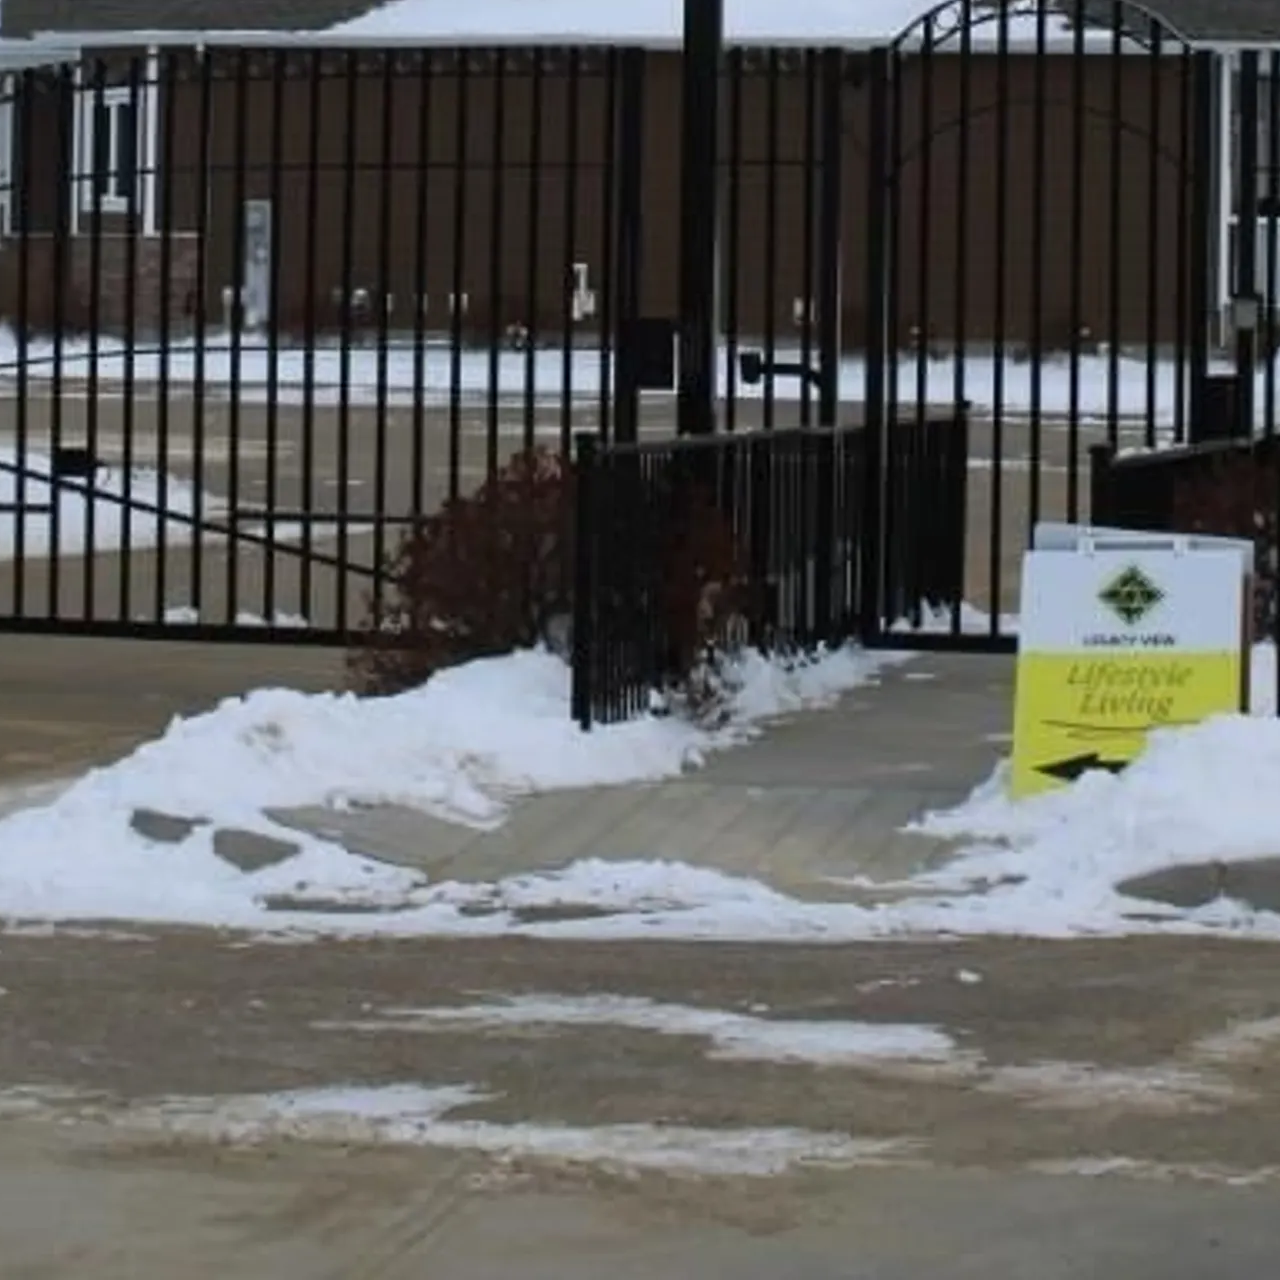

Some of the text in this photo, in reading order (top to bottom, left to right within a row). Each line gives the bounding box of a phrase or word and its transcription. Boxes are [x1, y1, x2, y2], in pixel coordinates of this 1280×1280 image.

[1140, 633, 1175, 648] VIEW
[1066, 662, 1194, 691] Lifestyle
[1079, 690, 1173, 721] Living
